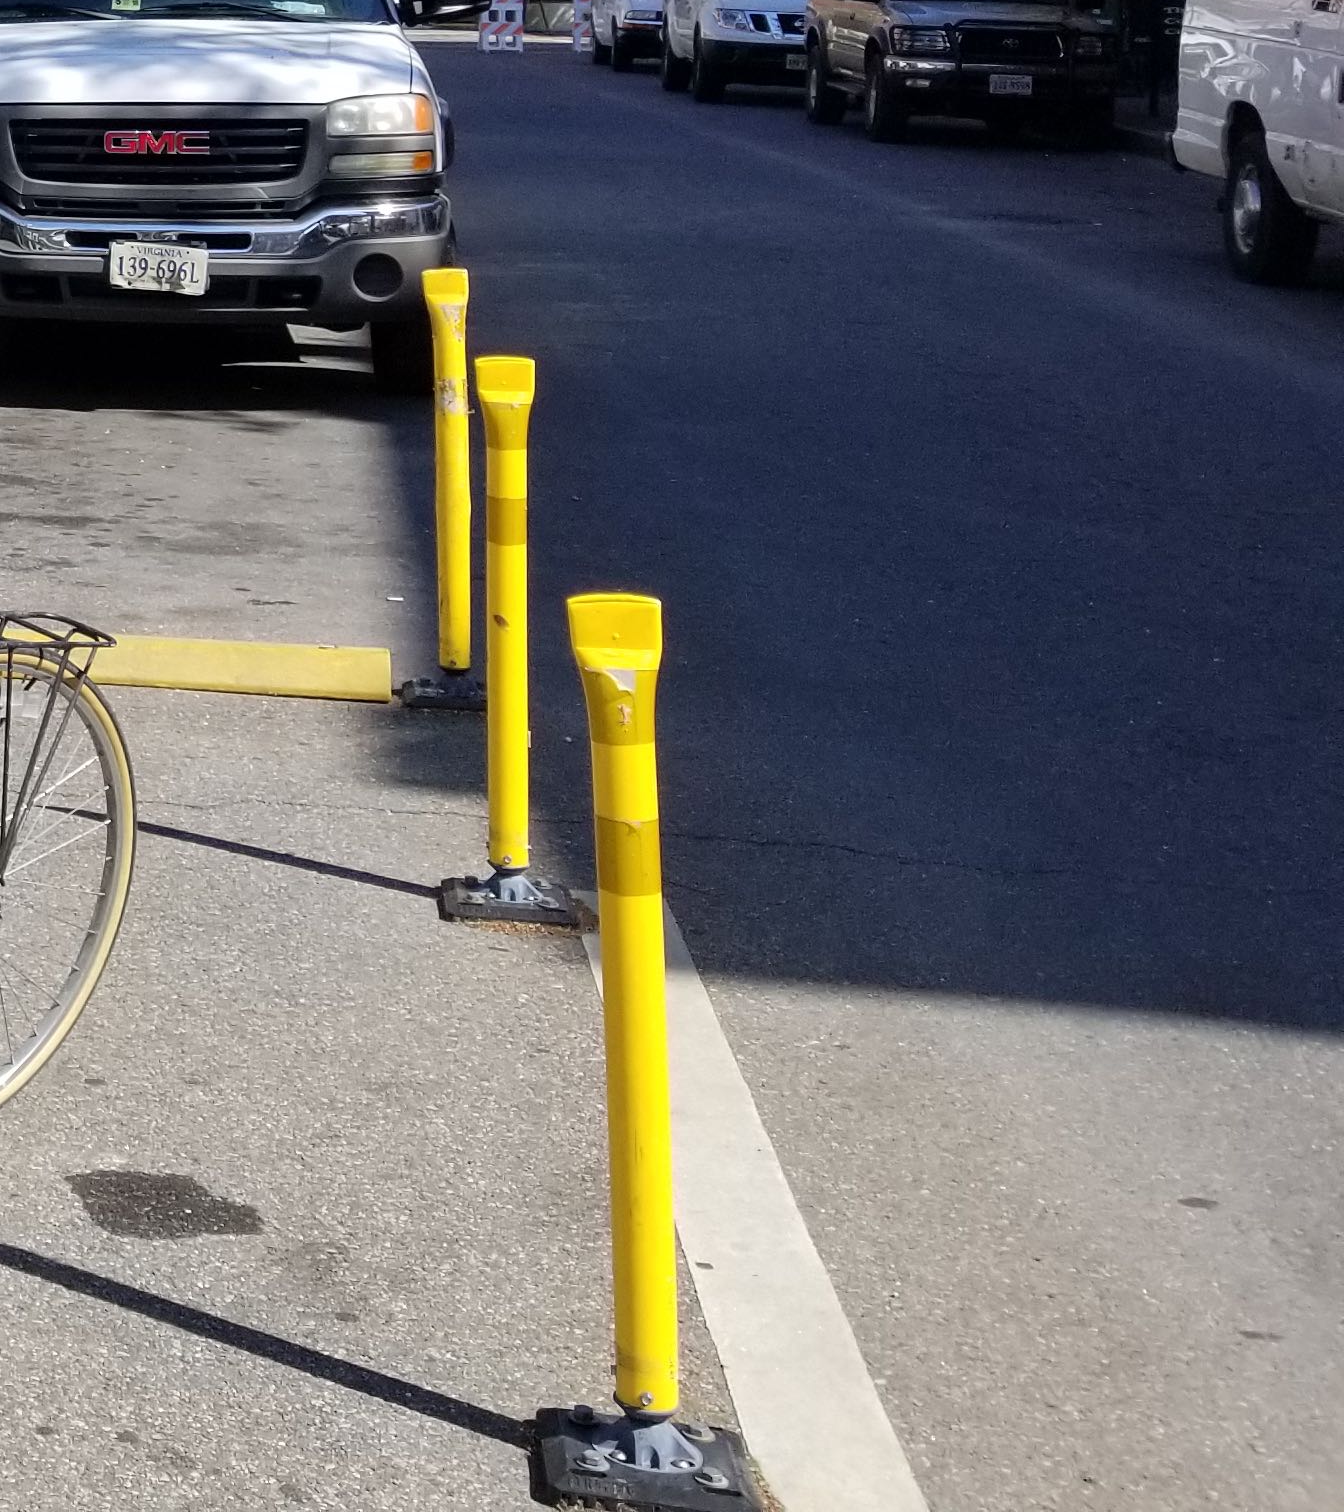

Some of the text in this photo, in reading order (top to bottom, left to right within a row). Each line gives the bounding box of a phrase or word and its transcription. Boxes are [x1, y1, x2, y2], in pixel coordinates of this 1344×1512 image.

[104, 130, 211, 155] GMC
[136, 246, 183, 258] VIRGINIA
[117, 255, 200, 284] 139-696L
